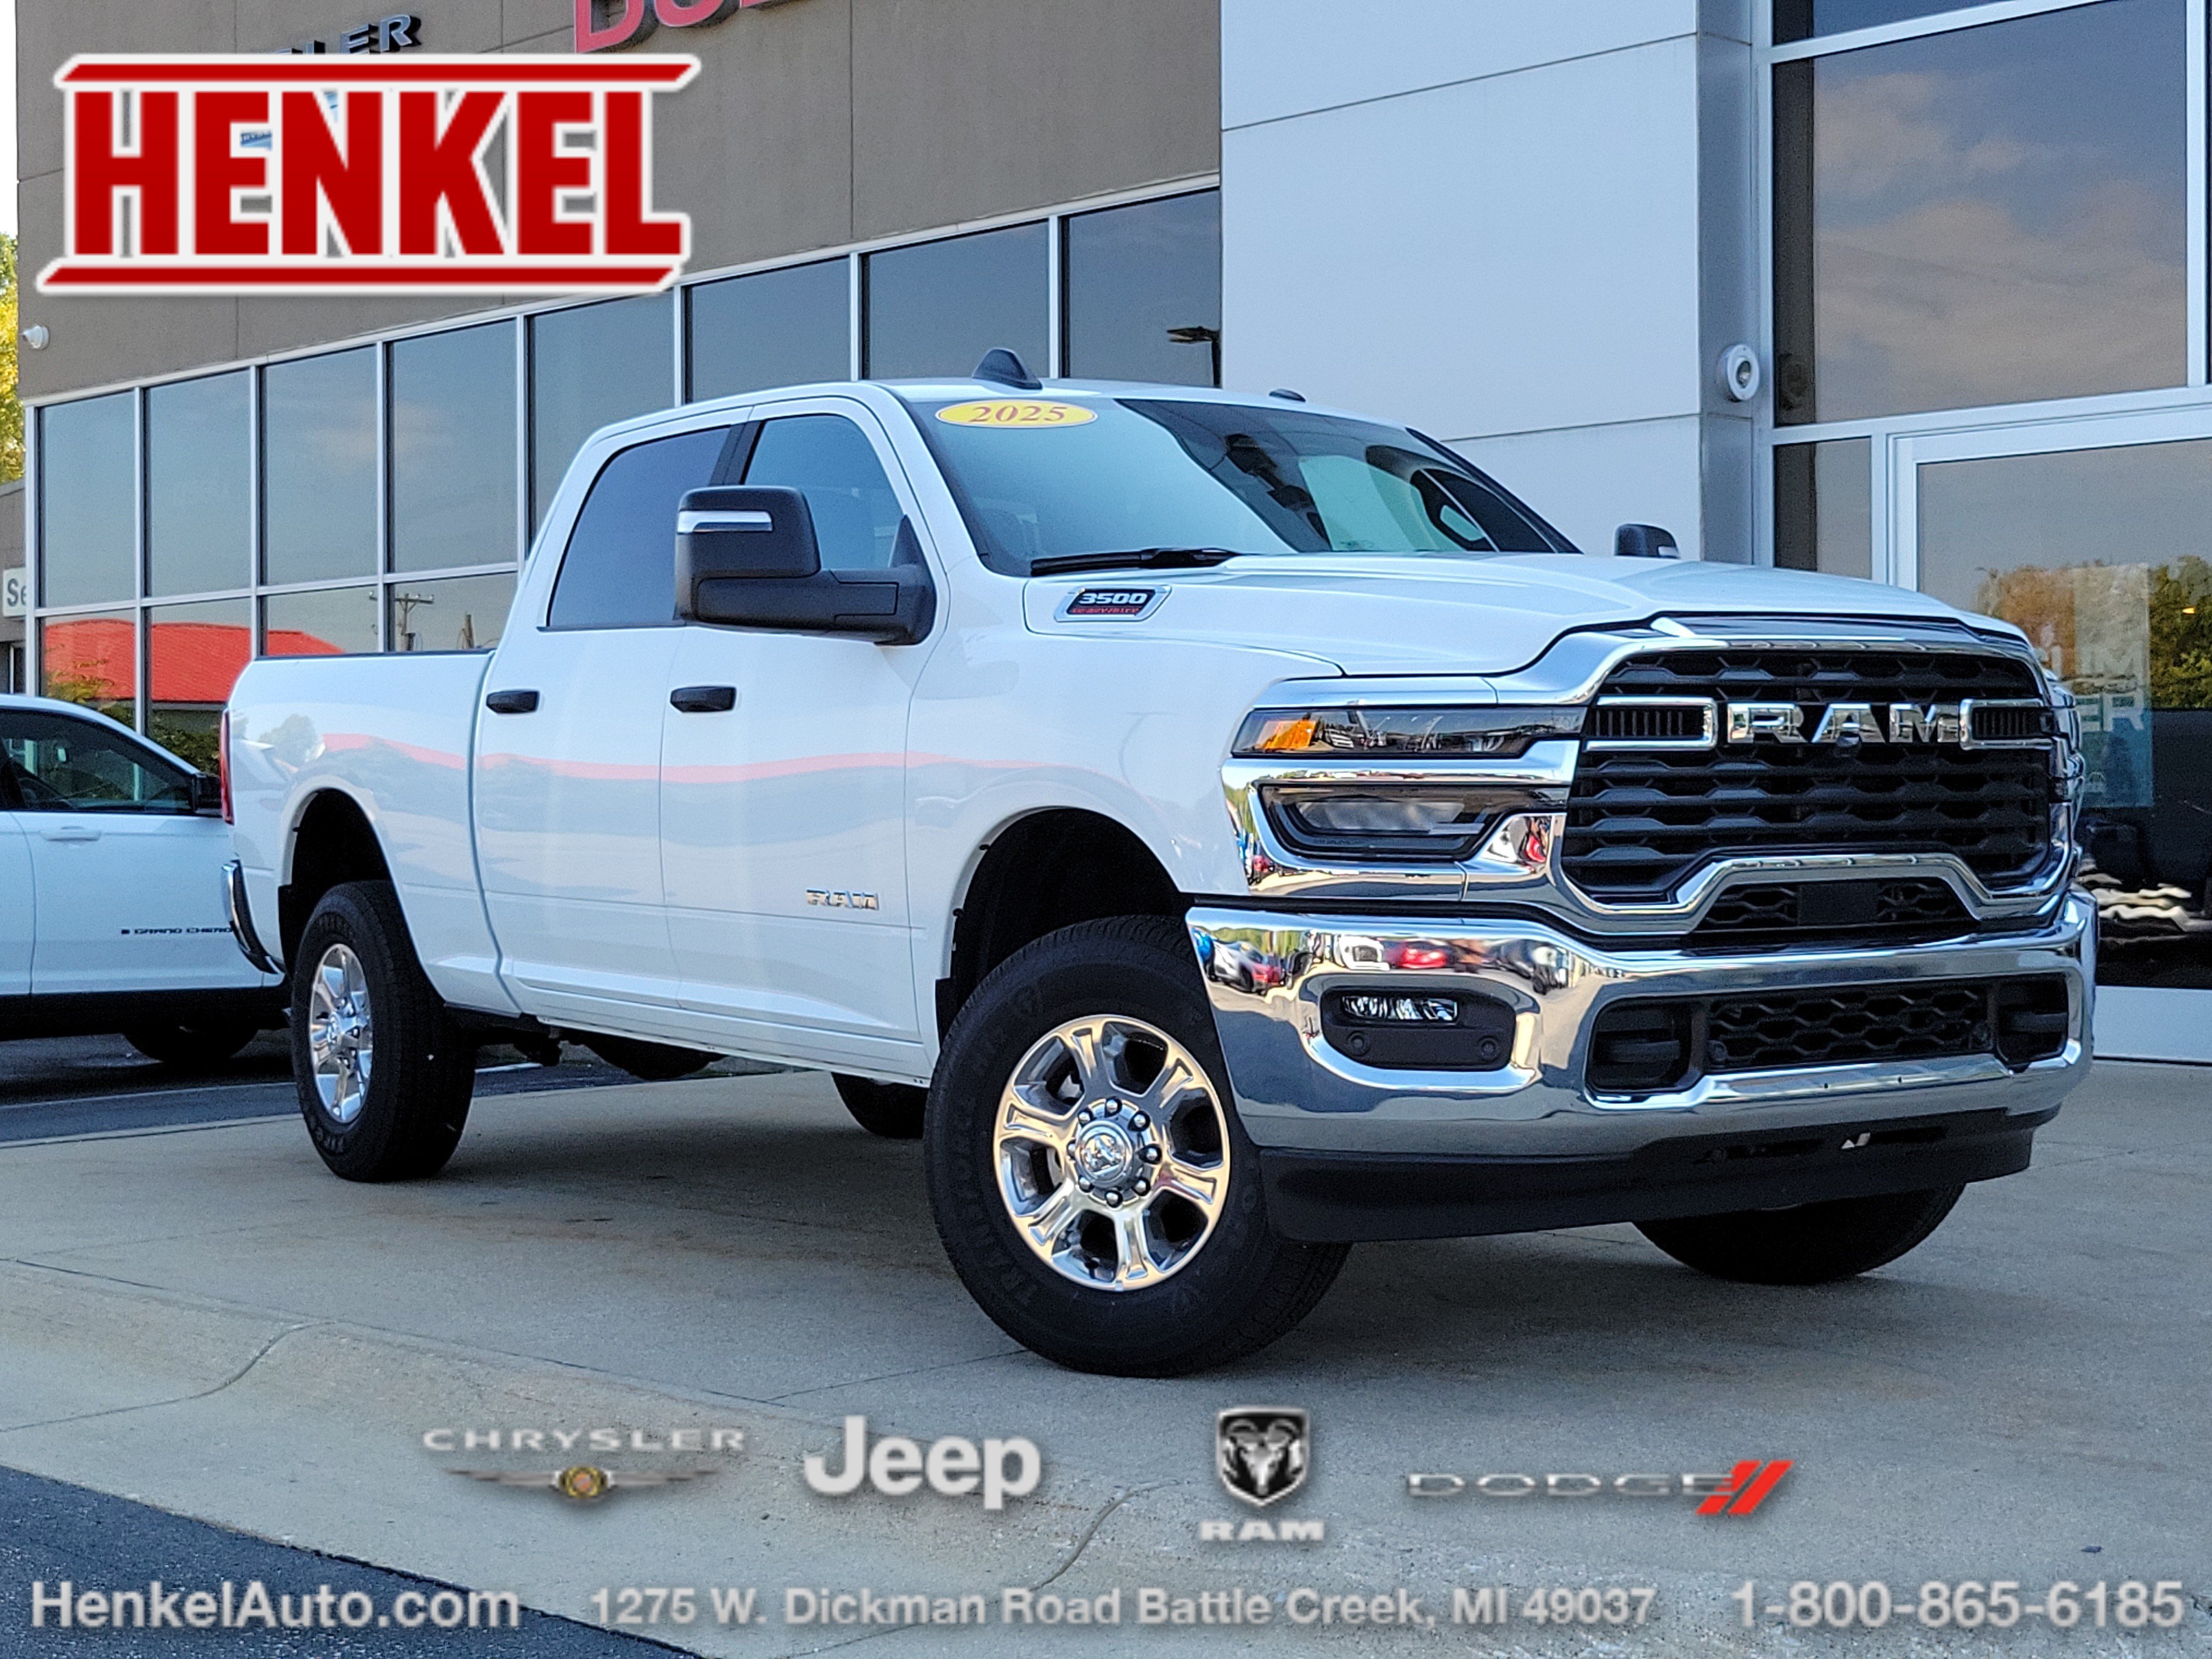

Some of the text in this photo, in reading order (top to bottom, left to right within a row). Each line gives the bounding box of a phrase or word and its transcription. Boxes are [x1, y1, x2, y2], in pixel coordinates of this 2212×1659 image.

[969, 405, 1068, 422] 2025
[1079, 592, 1148, 604] 3500
[1727, 703, 1960, 743] RAM
